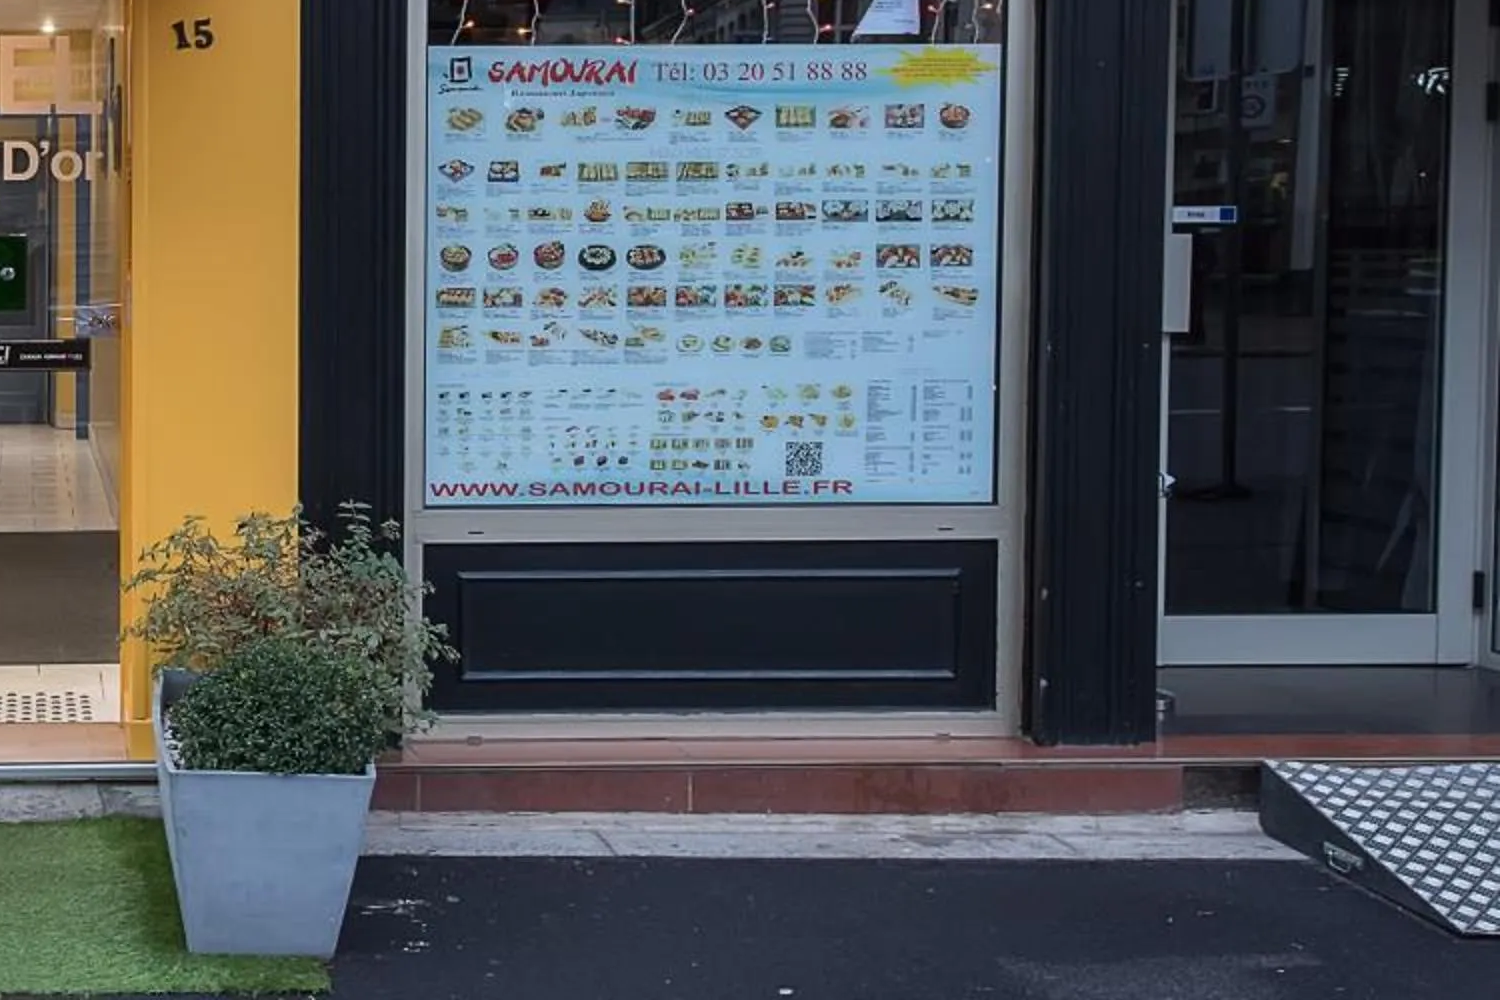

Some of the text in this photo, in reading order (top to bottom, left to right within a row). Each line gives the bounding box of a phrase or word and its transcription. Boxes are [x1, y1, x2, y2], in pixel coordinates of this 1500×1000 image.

[171, 18, 214, 50] 15
[487, 57, 639, 87] SAMOURAI
[651, 60, 695, 82] Tél:
[703, 60, 729, 82] 03
[738, 60, 764, 82] 20
[771, 60, 796, 82] 51
[806, 60, 833, 82] 88
[841, 60, 868, 82] 88
[430, 481, 853, 497] WWW.SAMOURAI-LILLE.FR
